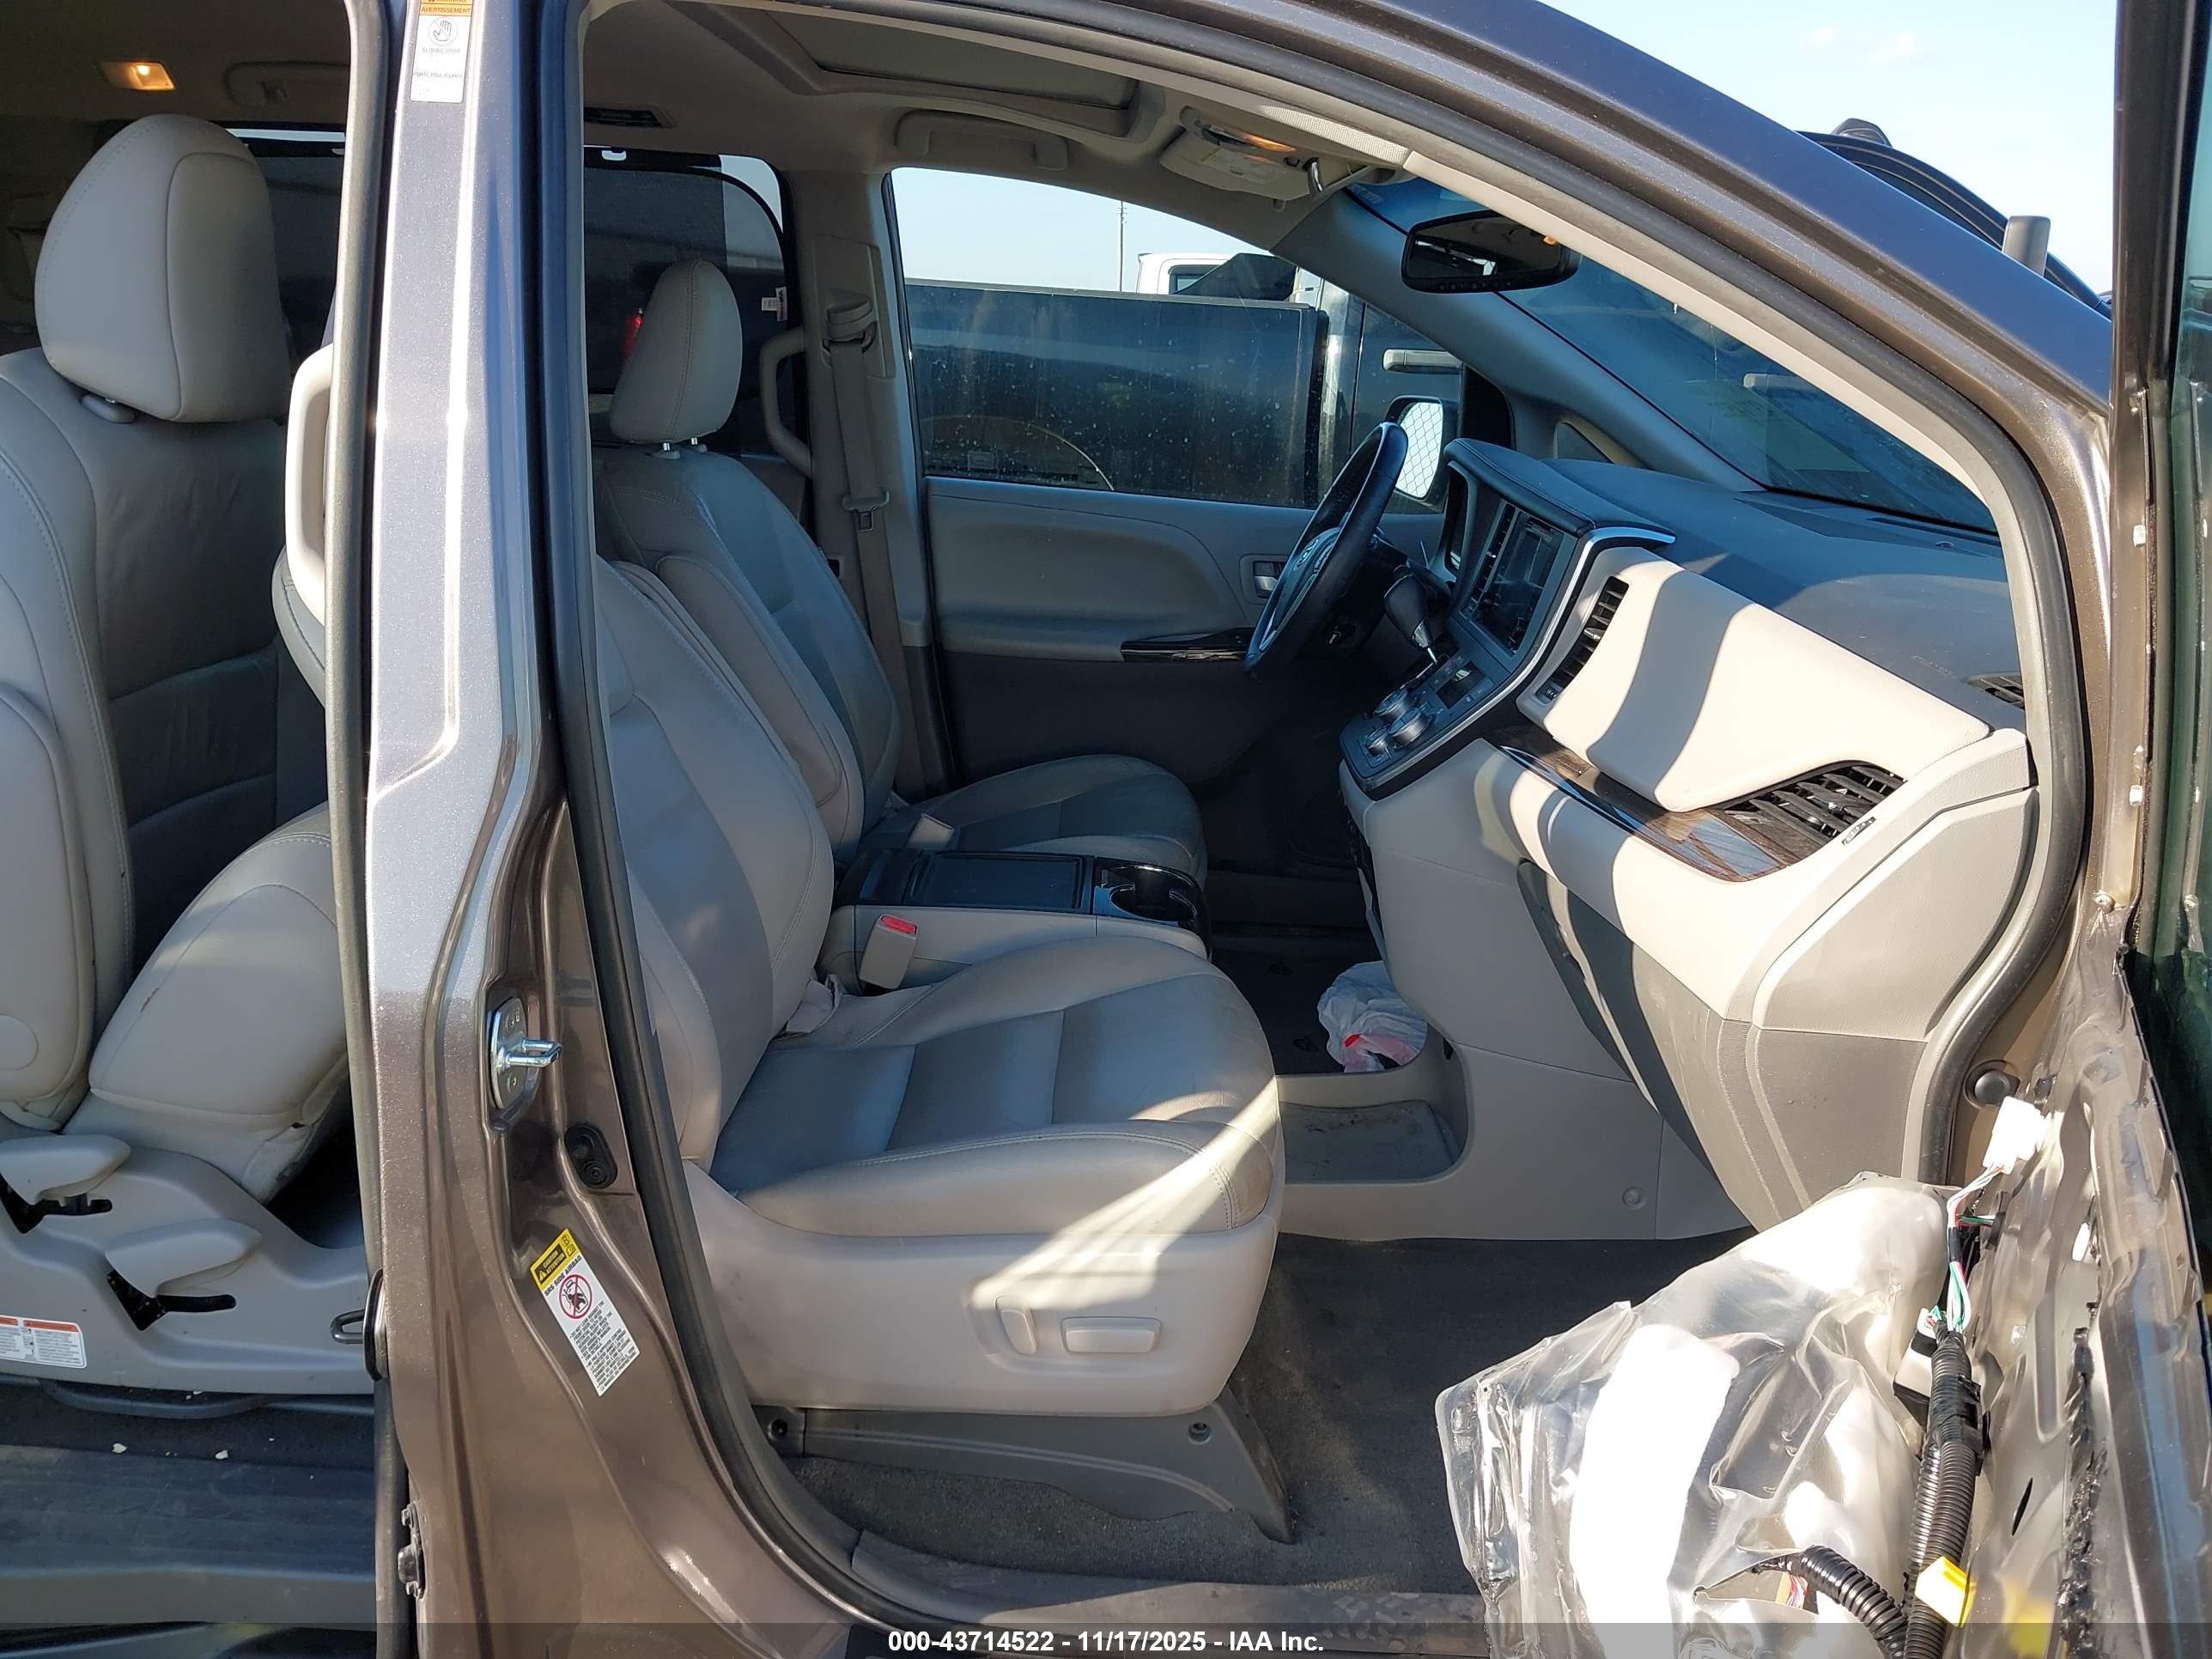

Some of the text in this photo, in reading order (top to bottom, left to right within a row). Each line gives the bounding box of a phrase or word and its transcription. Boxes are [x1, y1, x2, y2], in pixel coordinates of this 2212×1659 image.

[544, 1255, 582, 1297] SRS SIDE AIRBAG
